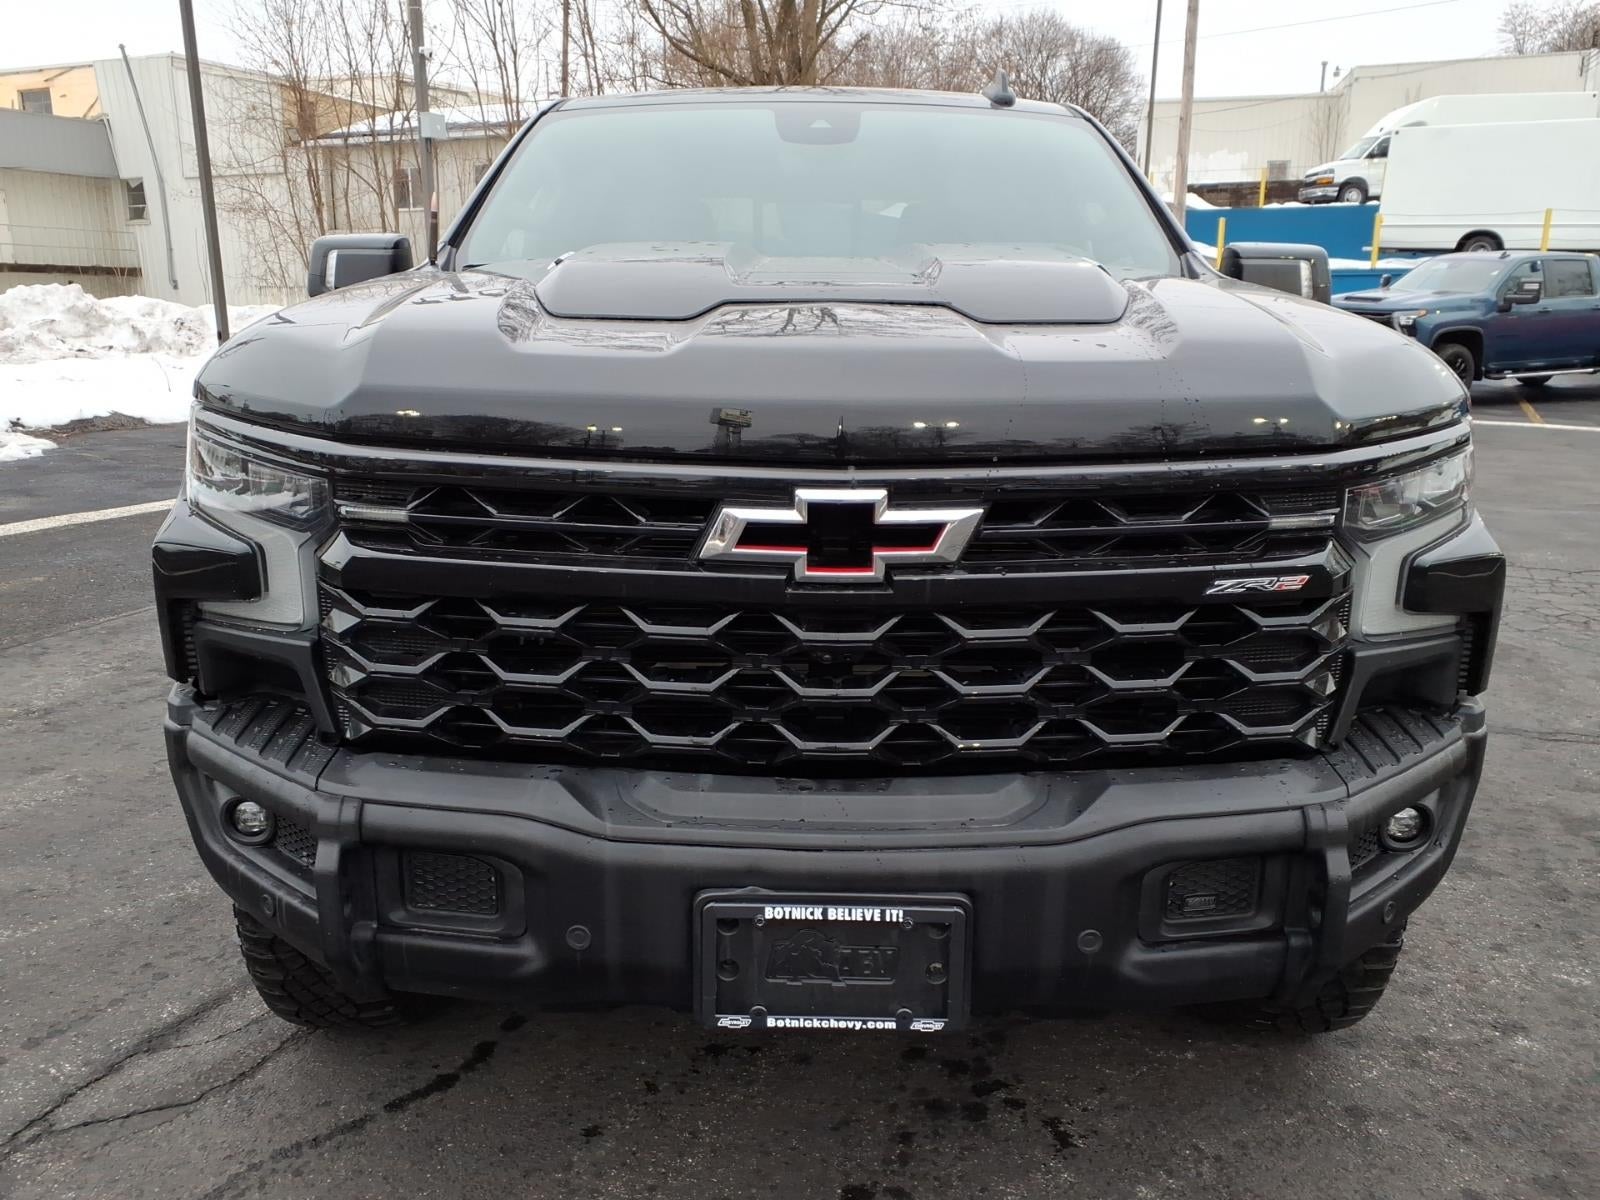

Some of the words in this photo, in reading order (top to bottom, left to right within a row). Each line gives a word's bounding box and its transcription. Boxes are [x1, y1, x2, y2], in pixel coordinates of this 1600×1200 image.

[1204, 575, 1311, 595] ZR2
[764, 906, 823, 921] BOTNICK
[828, 908, 881, 922] BELIEVE
[885, 909, 904, 923] IT!
[766, 1018, 897, 1030] Botnickchevy.com
